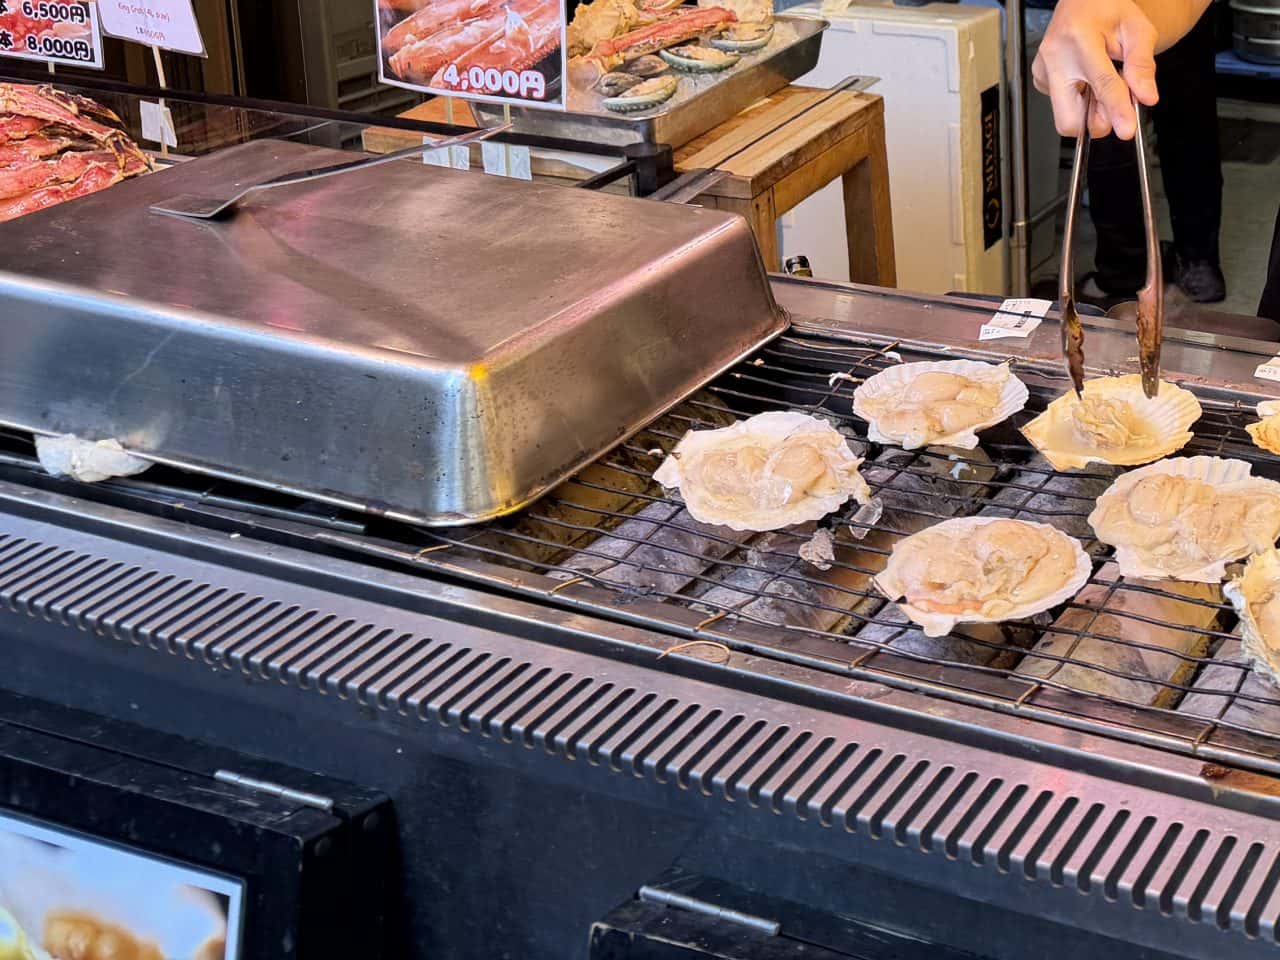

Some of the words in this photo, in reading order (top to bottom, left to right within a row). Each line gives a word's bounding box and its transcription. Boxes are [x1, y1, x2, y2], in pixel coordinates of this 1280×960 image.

[22, 1, 86, 23] 6,500円
[27, 36, 90, 59] 8,000円
[443, 64, 547, 99] 4,000円
